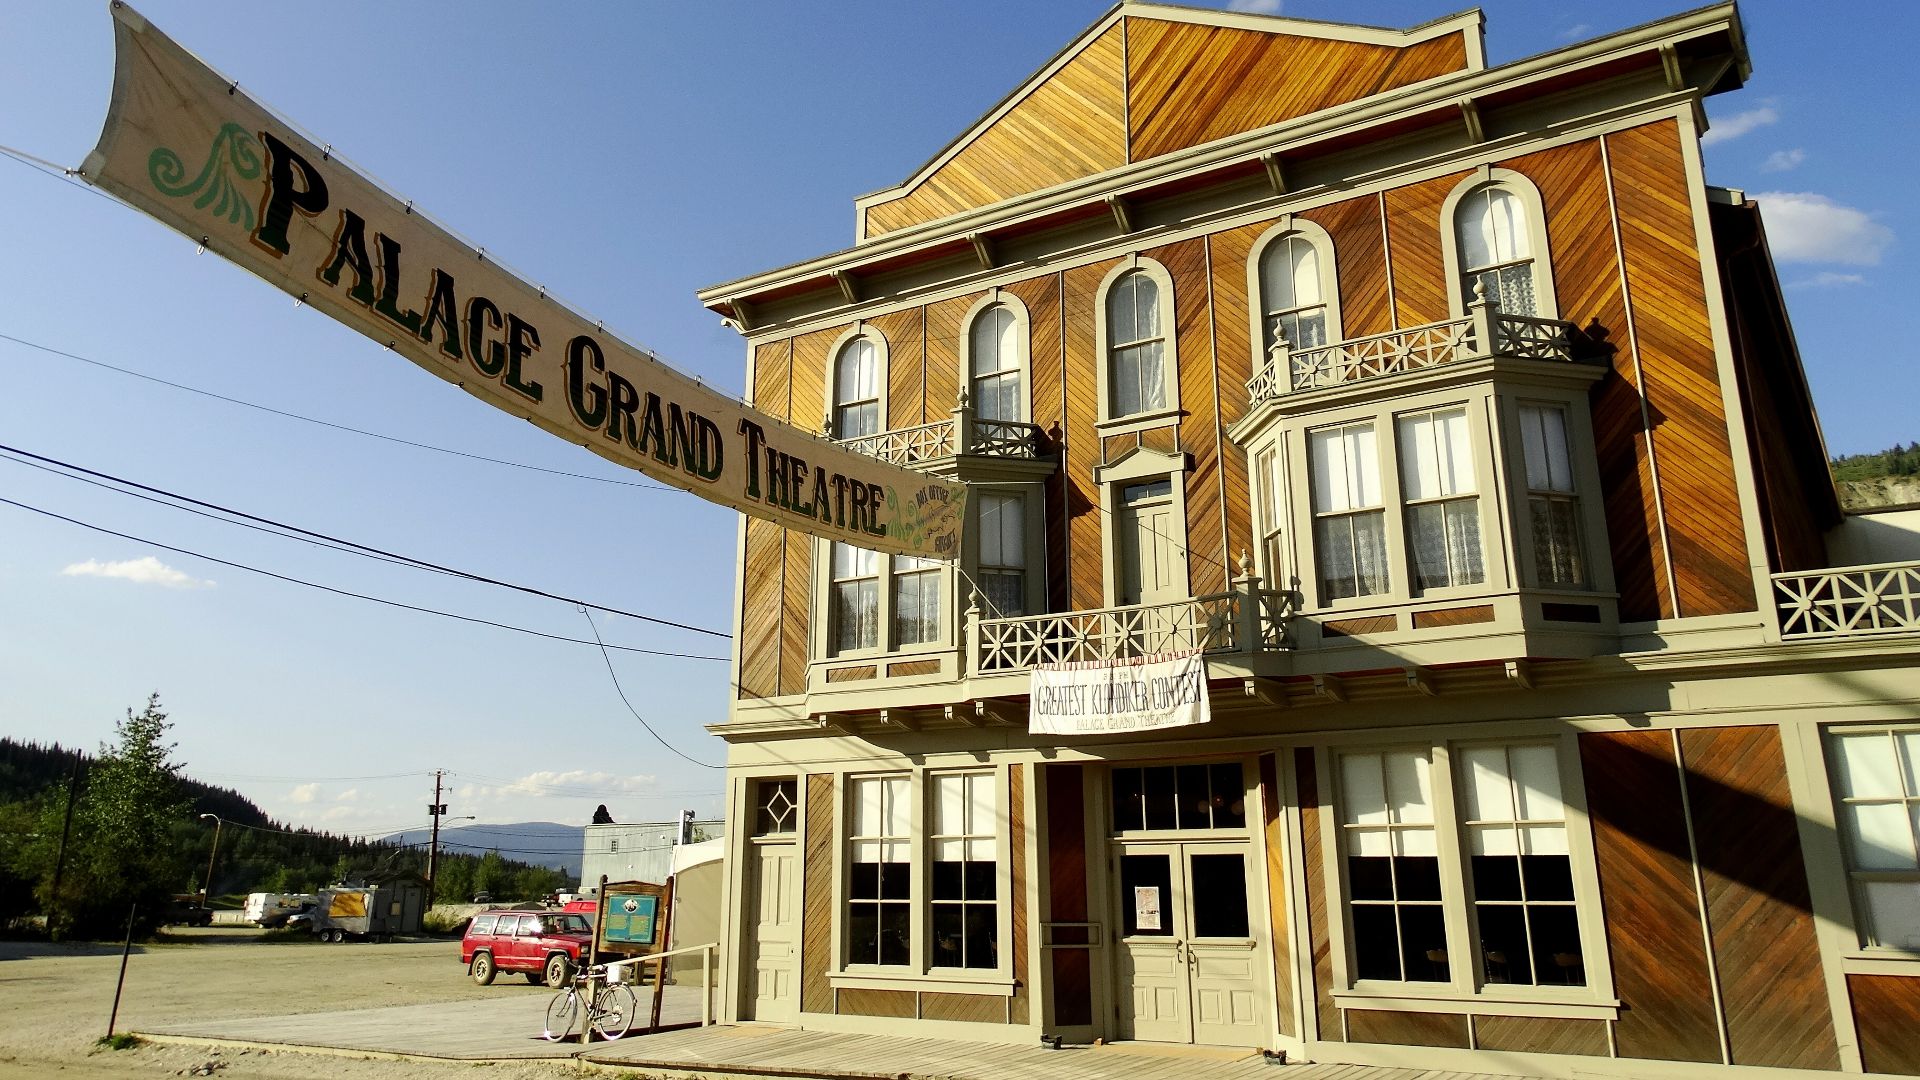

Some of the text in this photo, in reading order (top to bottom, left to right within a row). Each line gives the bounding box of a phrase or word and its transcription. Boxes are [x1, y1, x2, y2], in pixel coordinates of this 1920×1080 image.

[250, 131, 886, 538] PALACE GRAND THEATRE
[1037, 670, 1202, 716] GREATEST KLONDIKER CONTEST
[1107, 715, 1136, 729] GRAND
